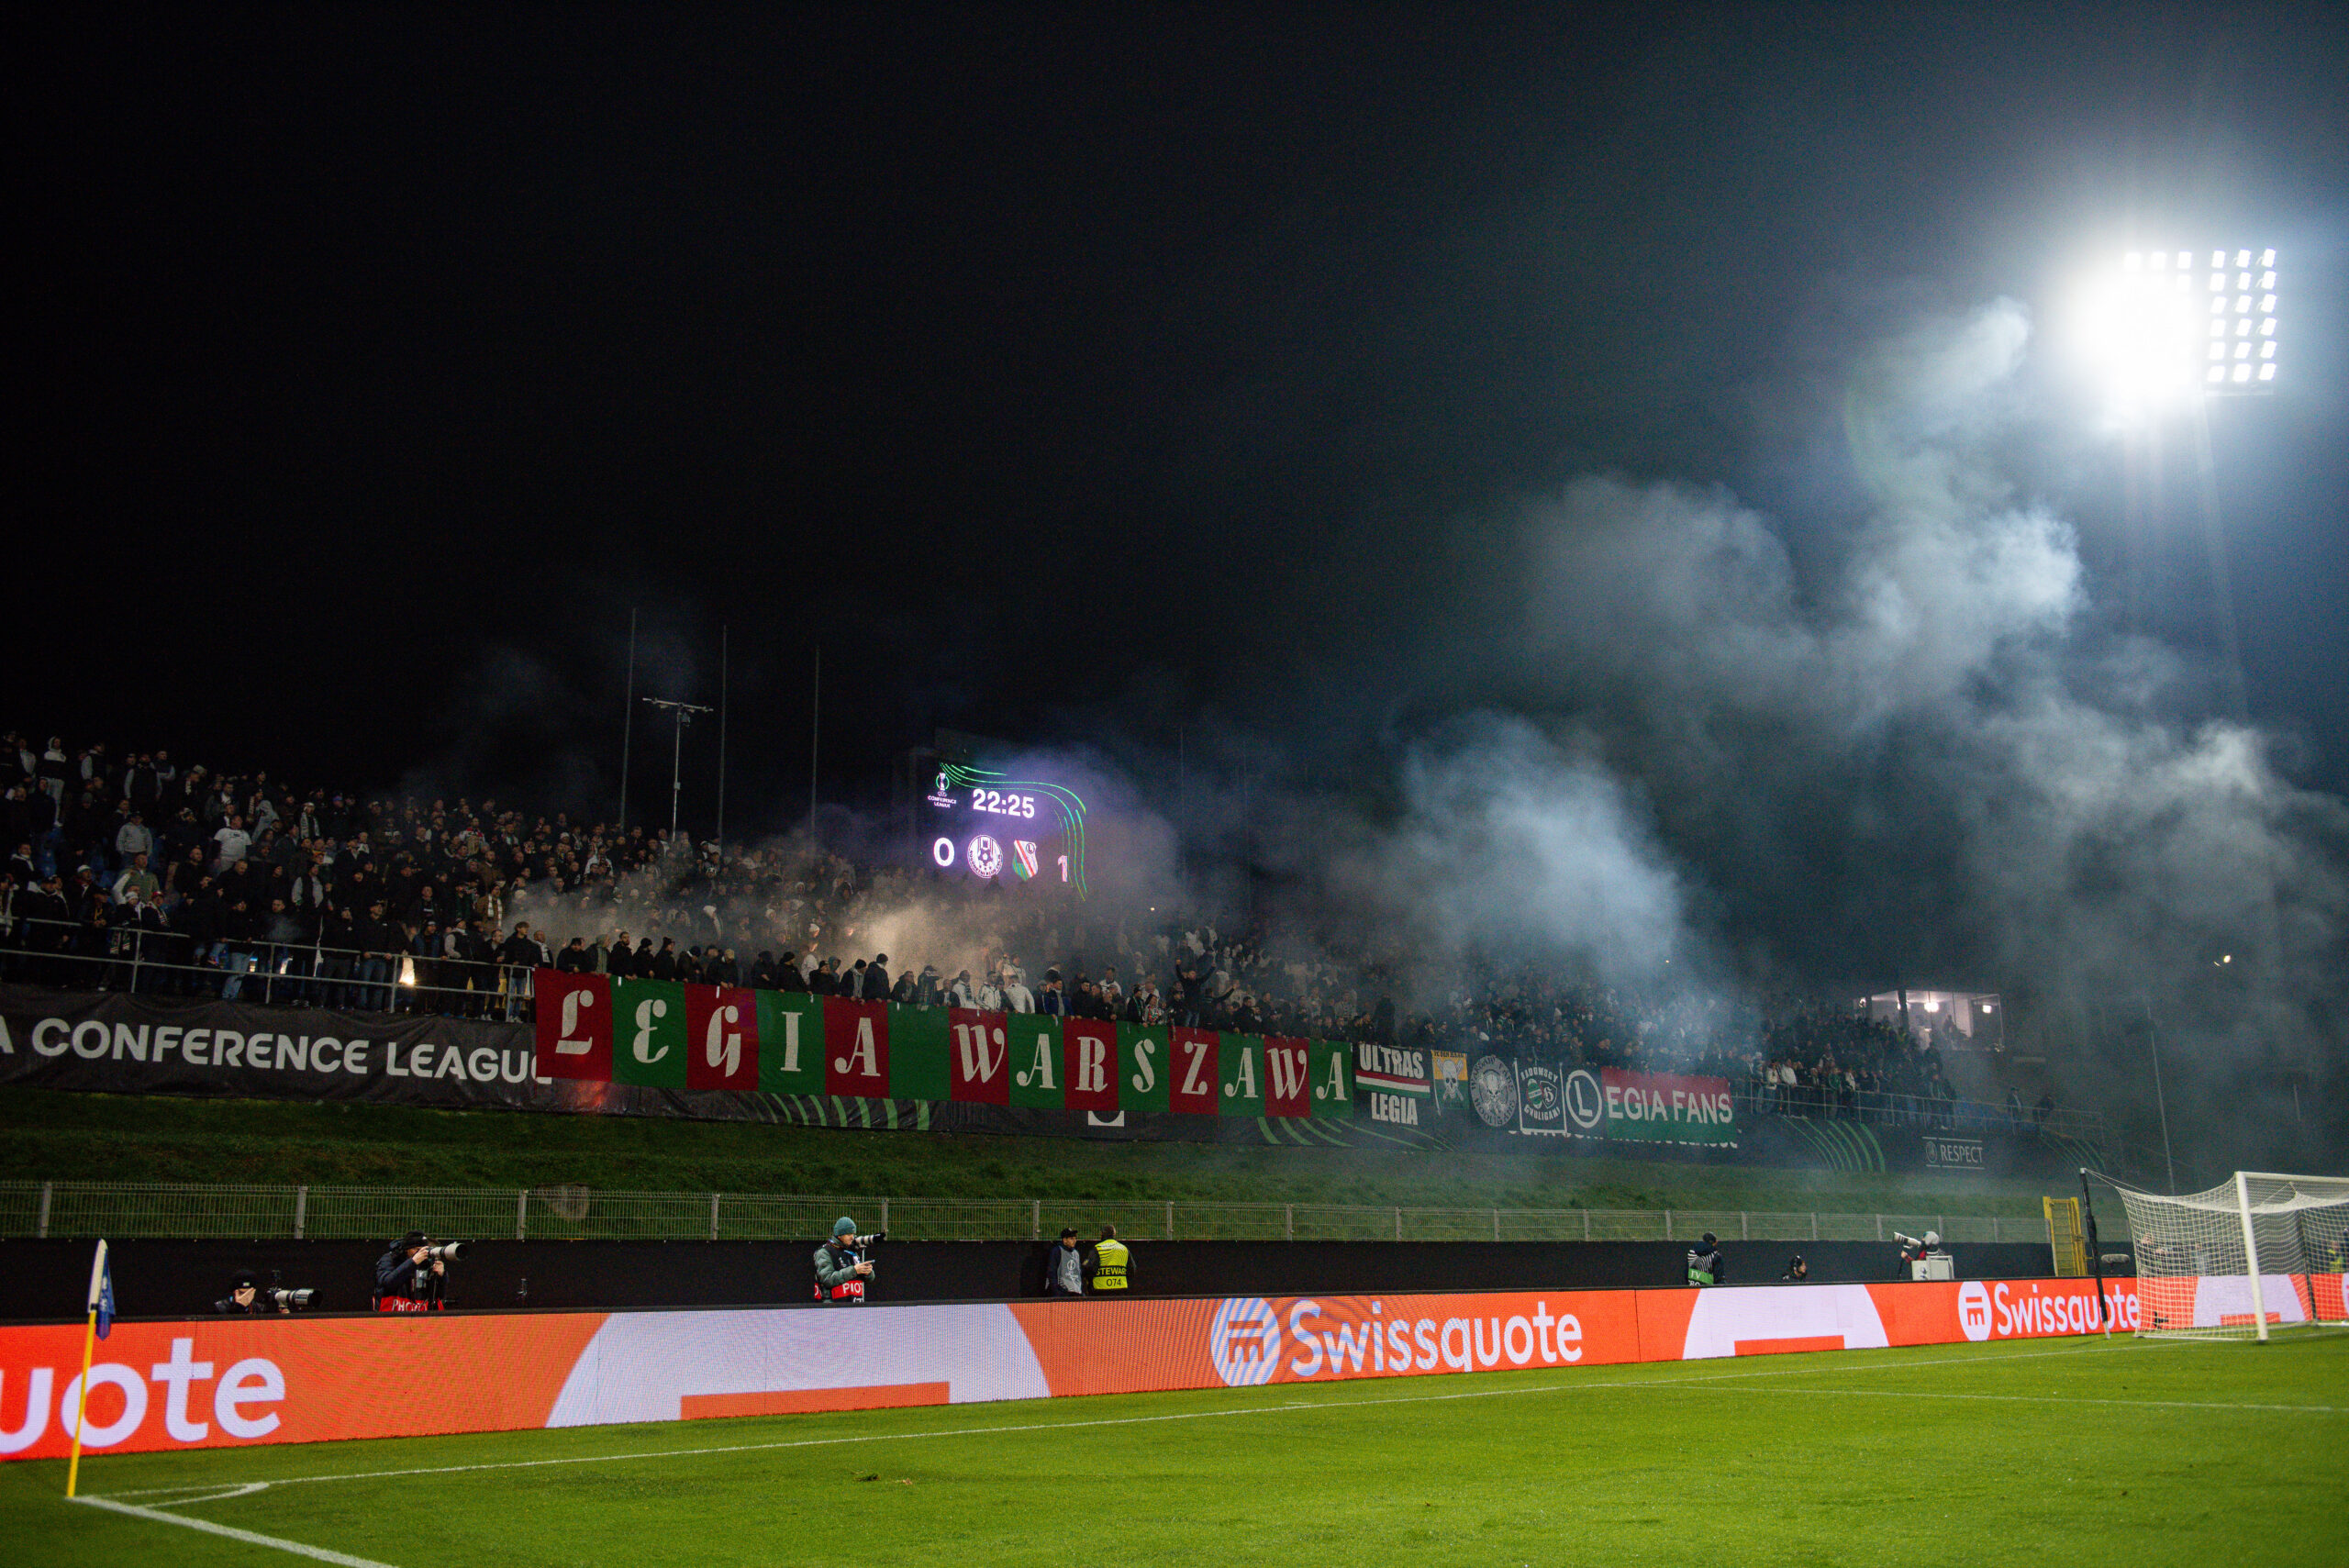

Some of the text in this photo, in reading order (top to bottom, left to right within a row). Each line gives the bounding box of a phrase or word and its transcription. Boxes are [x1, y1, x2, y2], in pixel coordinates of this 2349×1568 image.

[973, 789, 1035, 818] 22:25
[933, 838, 955, 867] 0
[1057, 855, 1068, 883] 1
[31, 1018, 369, 1074] CONFERENCE
[555, 990, 1348, 1101] LEGIA WARSZAWA
[1359, 1043, 1424, 1079] ULTRAS
[1371, 1092, 1418, 1126] LEGIA
[1672, 1090, 1733, 1125] FANS
[1940, 1144, 1983, 1163] RESPECT
[1994, 1283, 2142, 1336] Swissquote
[1289, 1299, 1583, 1376] Swissquote
